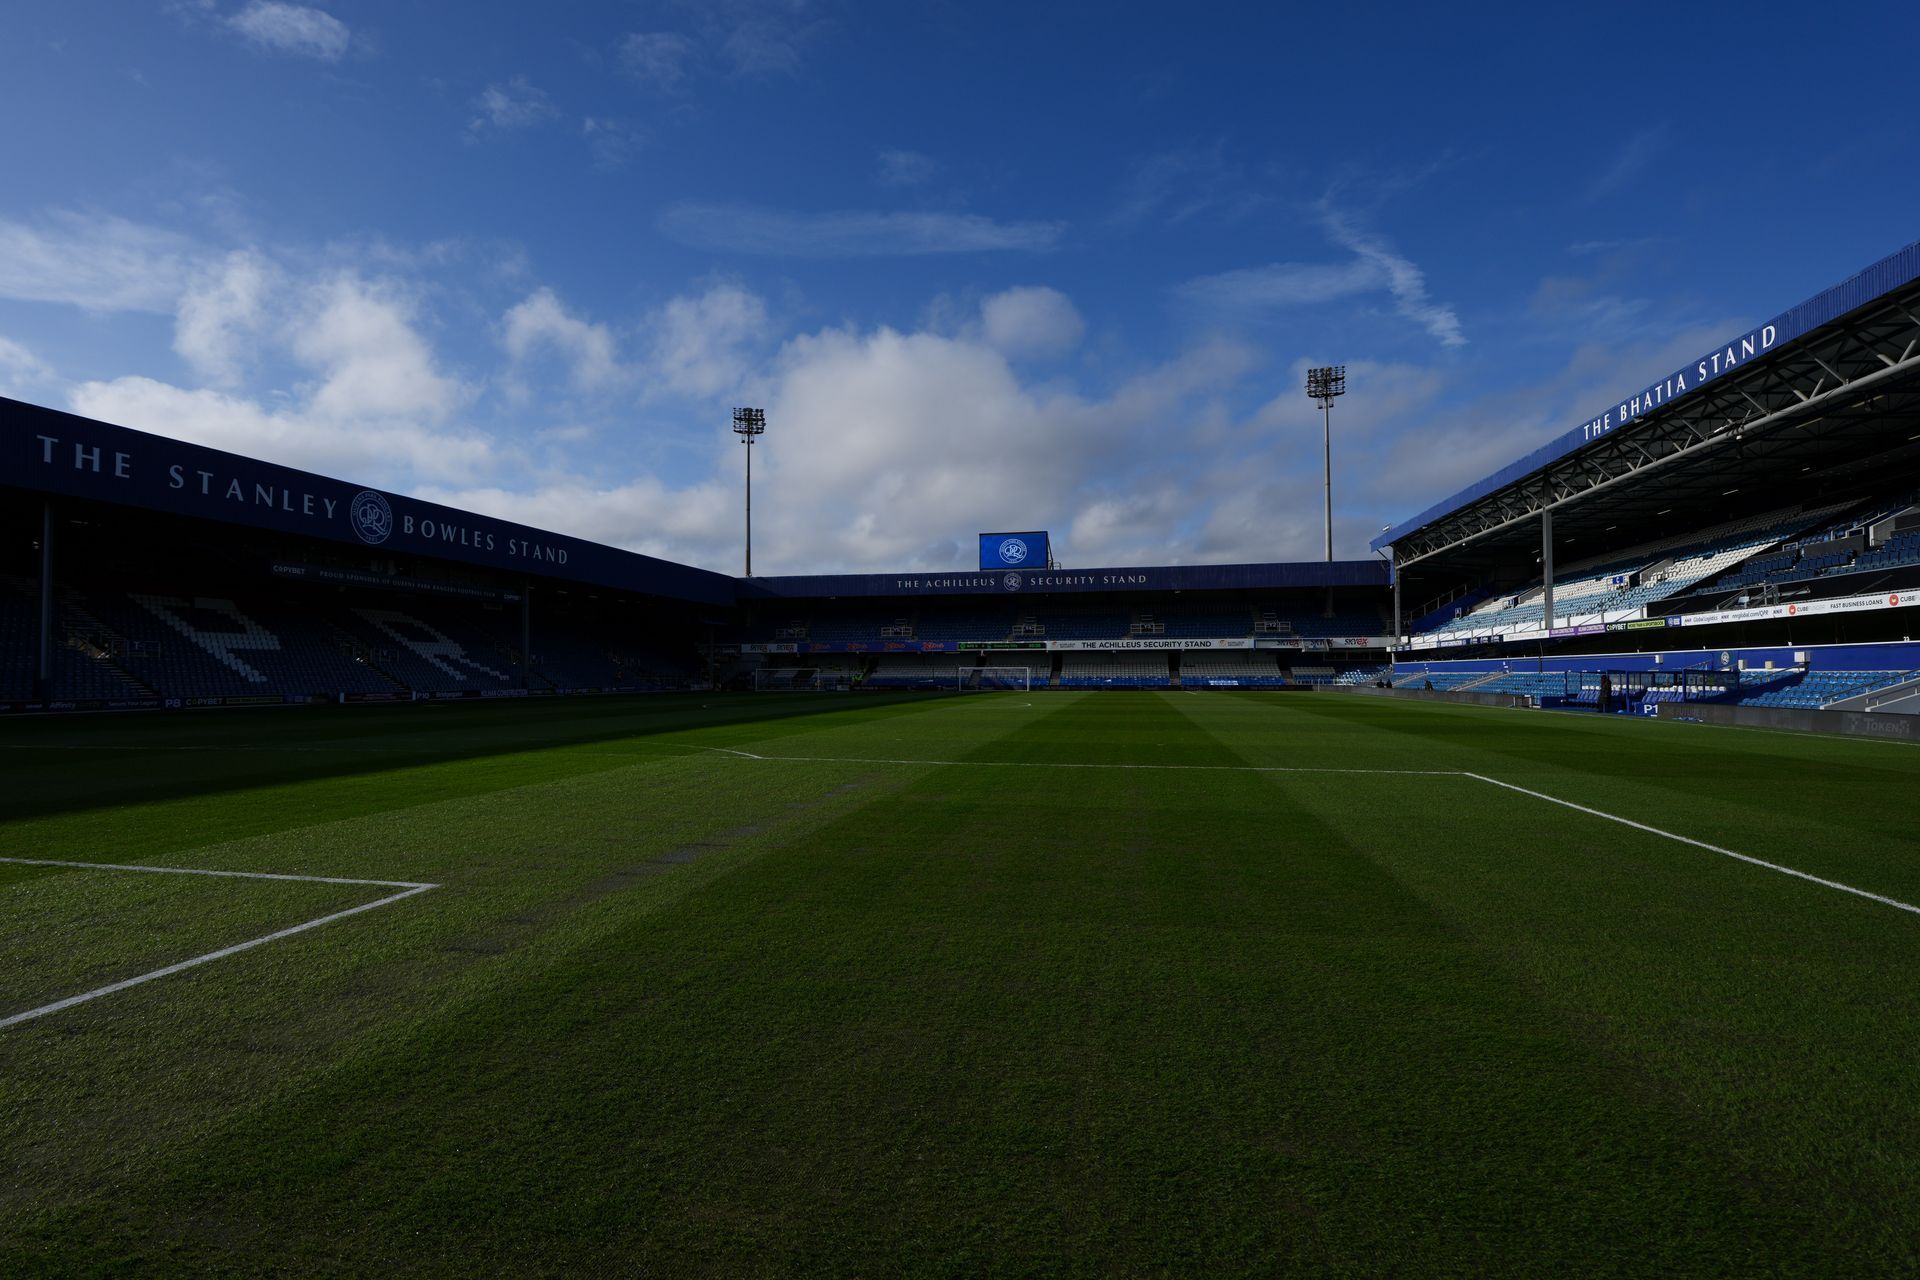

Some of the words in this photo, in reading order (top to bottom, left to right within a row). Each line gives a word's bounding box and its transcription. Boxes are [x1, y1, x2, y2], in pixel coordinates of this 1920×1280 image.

[1583, 413, 1610, 441] THE
[1620, 373, 1686, 422] BHATIA
[1698, 325, 1776, 382] STAND
[35, 434, 131, 480] THE
[167, 464, 337, 519] STANLEY
[403, 515, 495, 551] BOWLES
[508, 538, 568, 565] STAND
[897, 580, 920, 588] THE
[925, 578, 996, 588] ACHILLEUS
[1030, 576, 1096, 586] SECURITY
[1103, 575, 1148, 584] STAND
[1184, 640, 1212, 648] STAND
[1643, 704, 1659, 713] P1
